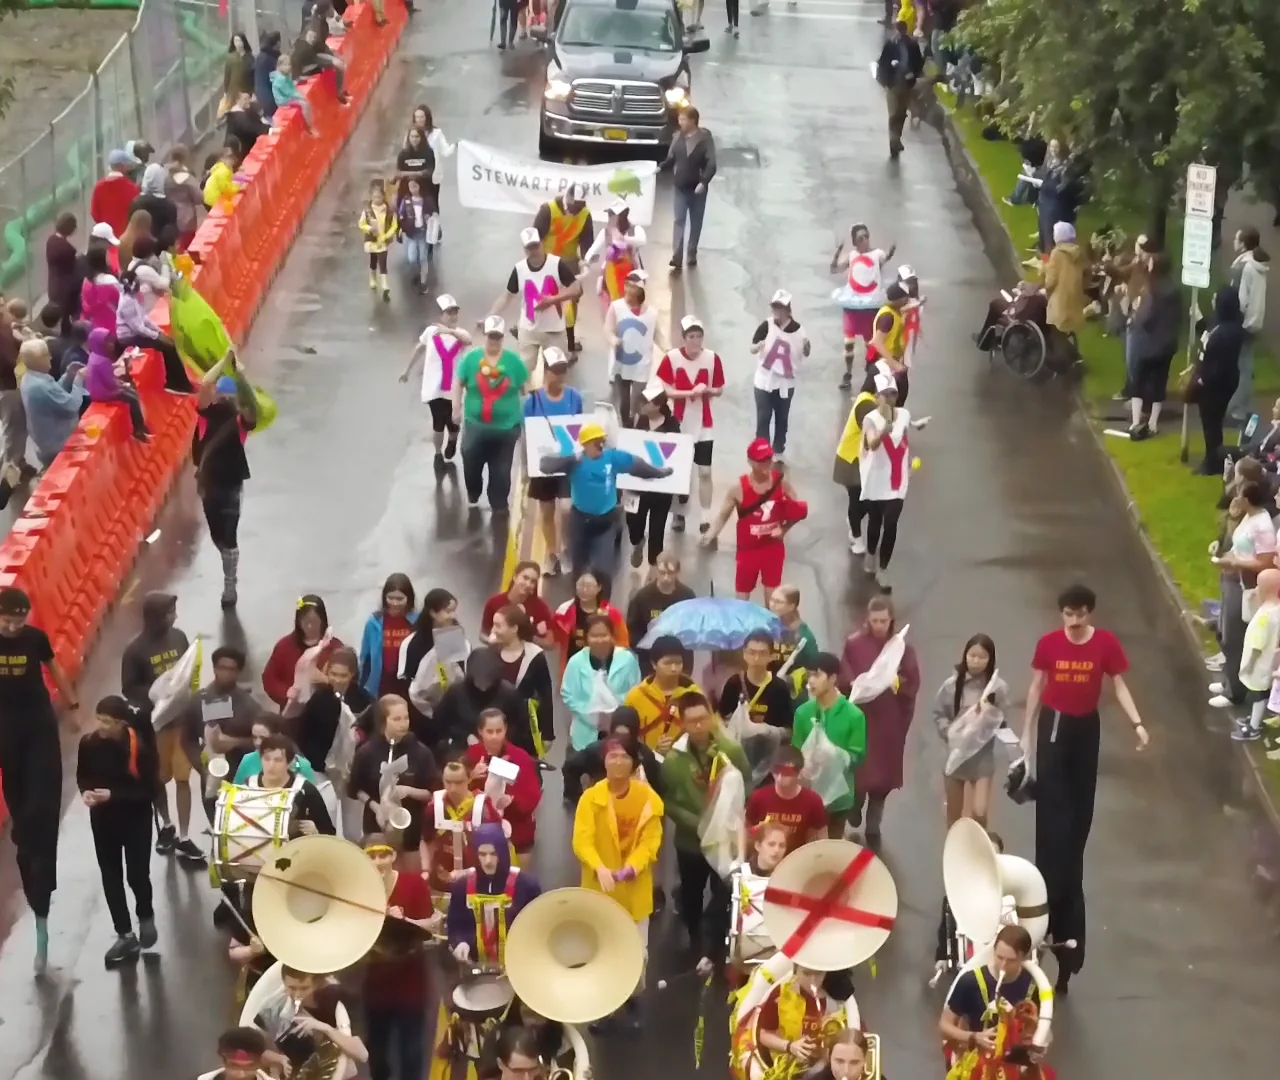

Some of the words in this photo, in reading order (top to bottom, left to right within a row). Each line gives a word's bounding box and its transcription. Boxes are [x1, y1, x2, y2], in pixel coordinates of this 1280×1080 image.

[472, 164, 552, 192] STEWART
[558, 178, 602, 196] PRK
[848, 255, 879, 293] C
[433, 335, 464, 391] Y
[615, 318, 648, 365] C
[762, 337, 795, 380] A
[673, 367, 713, 428] M
[881, 431, 908, 491] Y
